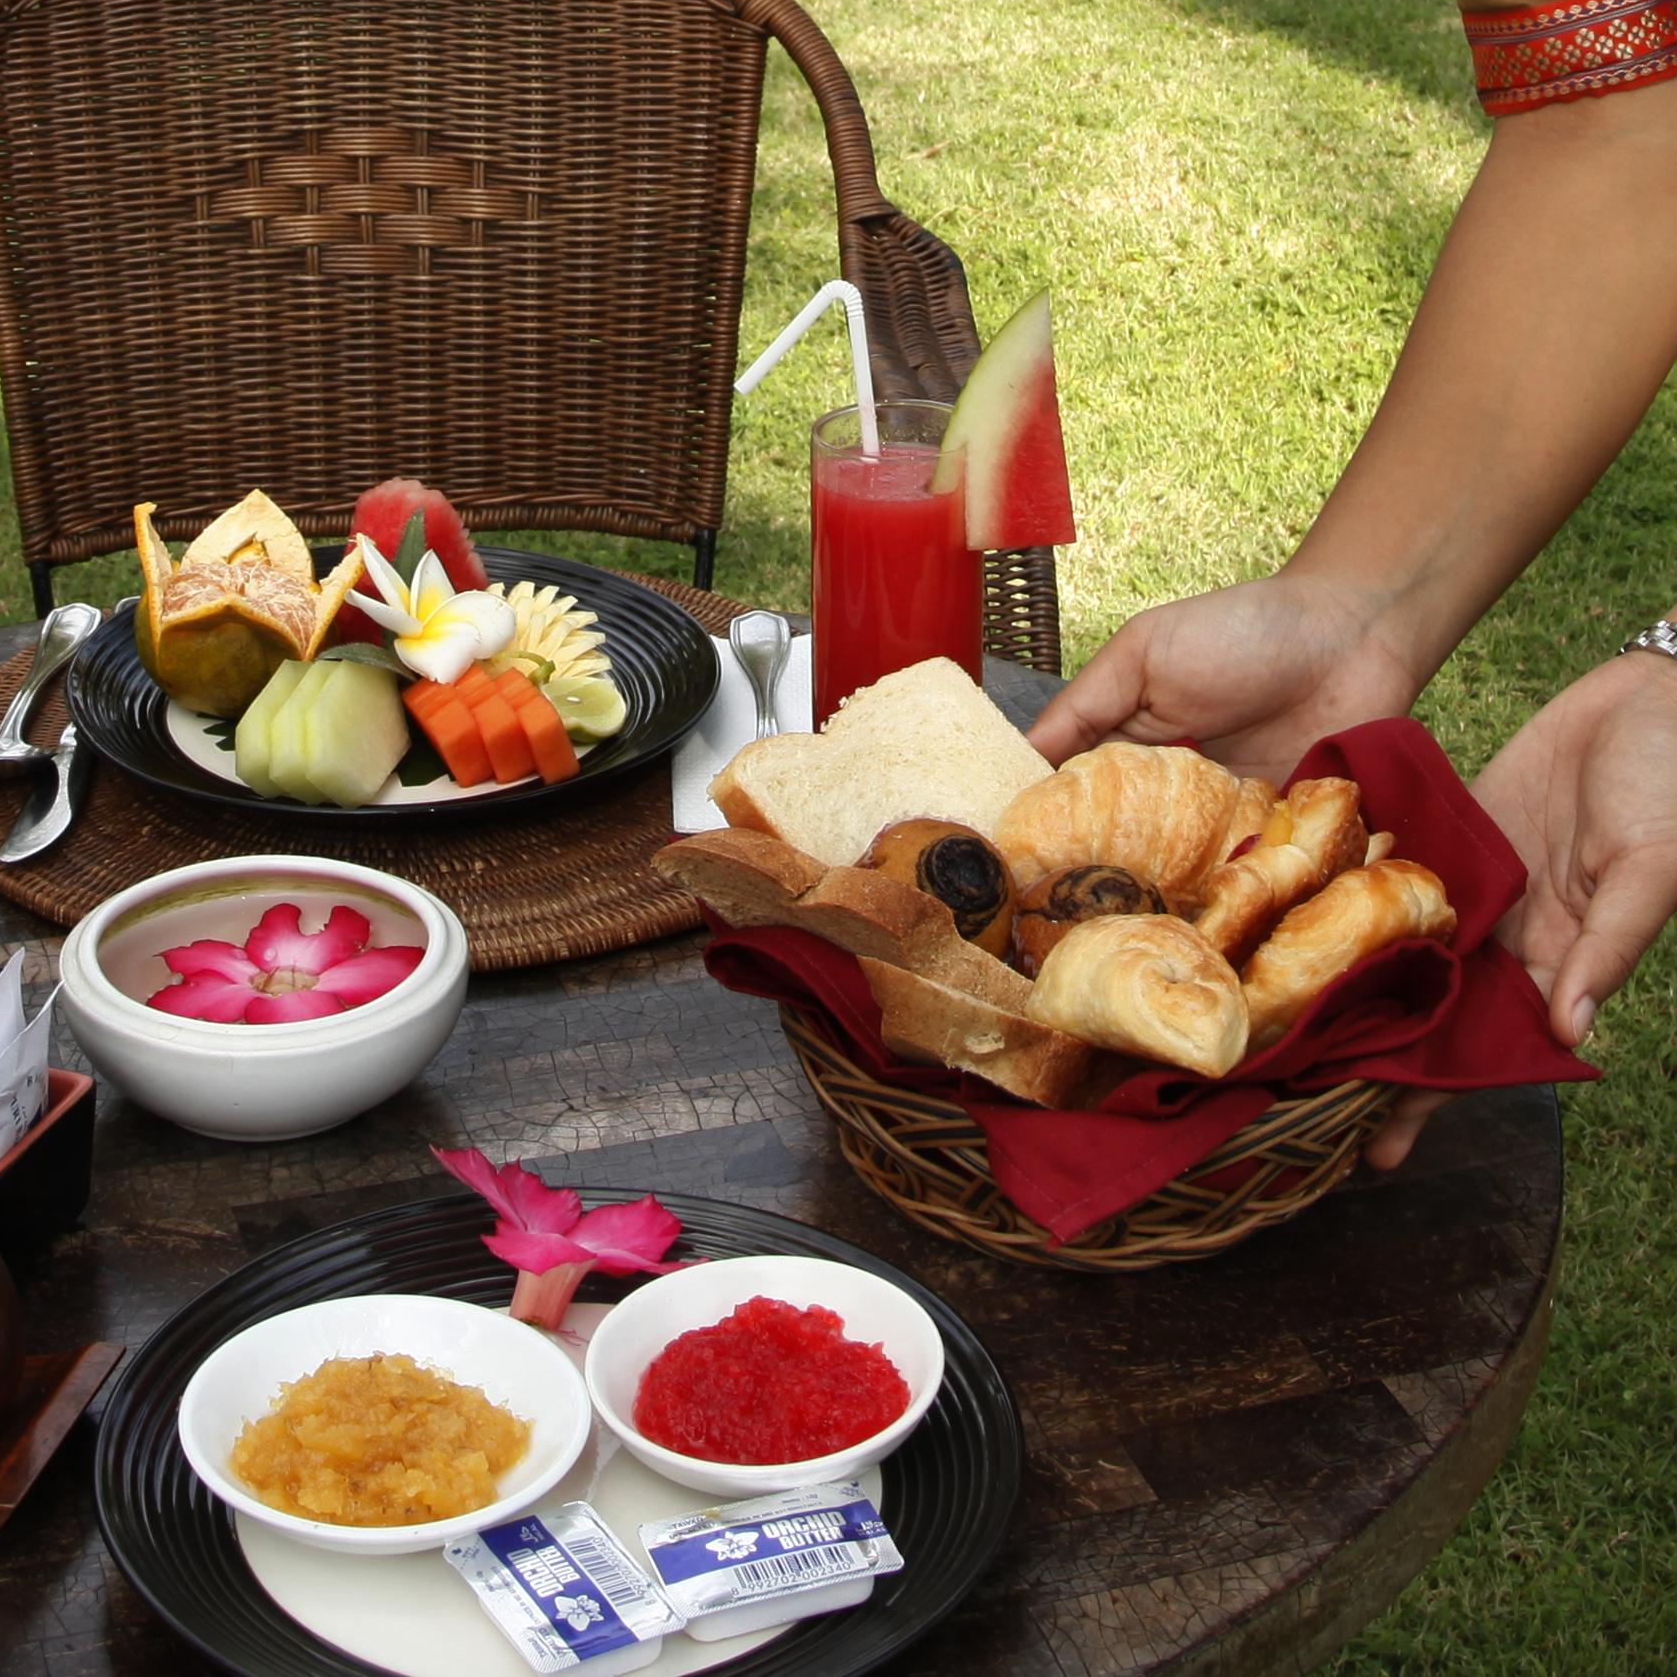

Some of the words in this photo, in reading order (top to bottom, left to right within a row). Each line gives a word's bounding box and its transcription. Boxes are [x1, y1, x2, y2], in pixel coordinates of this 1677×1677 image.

[761, 1511, 847, 1539] ORCHID
[778, 1526, 845, 1550] BUTTER
[506, 1547, 564, 1598] ORCHID
[536, 1545, 580, 1583] BUTTER
[730, 1587, 739, 1596] 8
[747, 1573, 797, 1593] 992702
[802, 1562, 851, 1580] 002340
